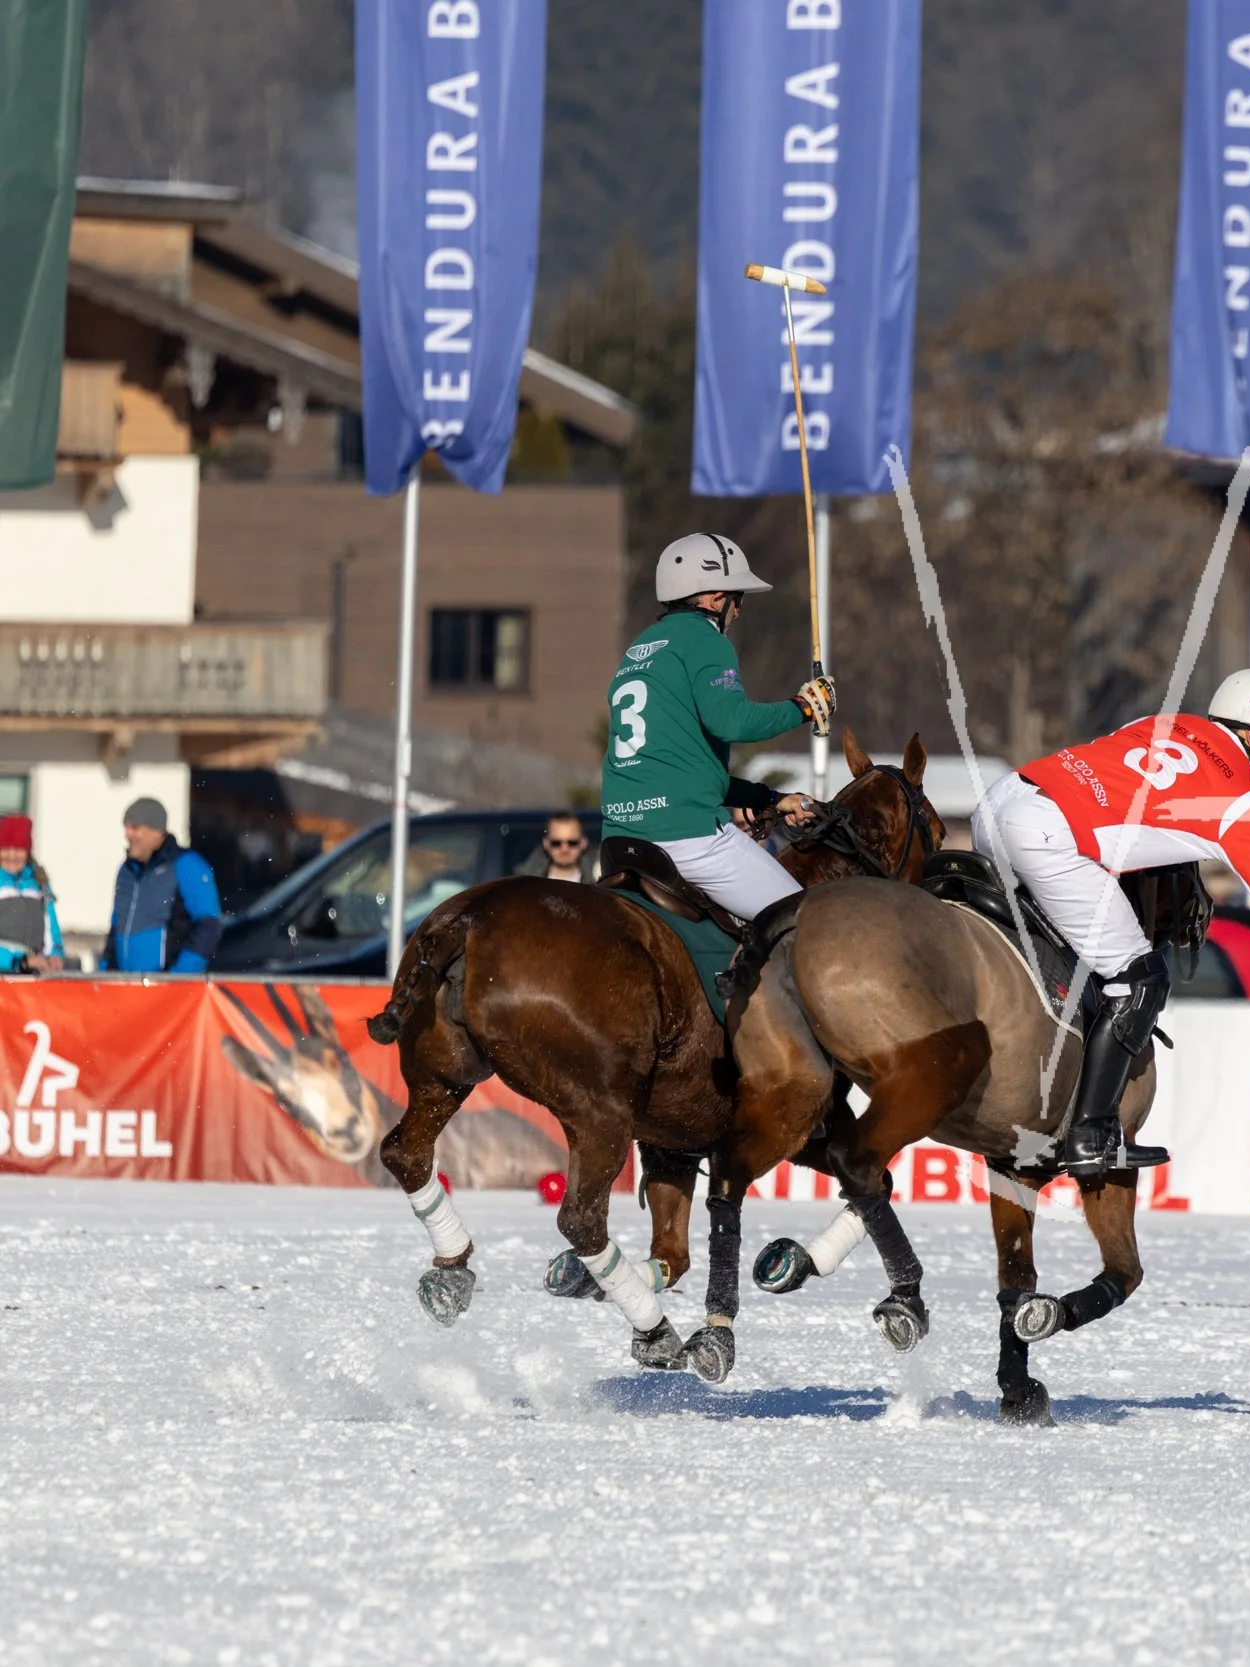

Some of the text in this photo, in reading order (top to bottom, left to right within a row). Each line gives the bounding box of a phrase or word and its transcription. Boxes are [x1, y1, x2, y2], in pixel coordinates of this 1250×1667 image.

[420, 70, 480, 449] BENDURA
[780, 62, 840, 451] BENDURA
[612, 680, 648, 758] 3
[1123, 739, 1199, 791] 3
[607, 802, 635, 815] POLO
[637, 796, 669, 812] ASSN.
[0, 1108, 173, 1158] ÜHEL
